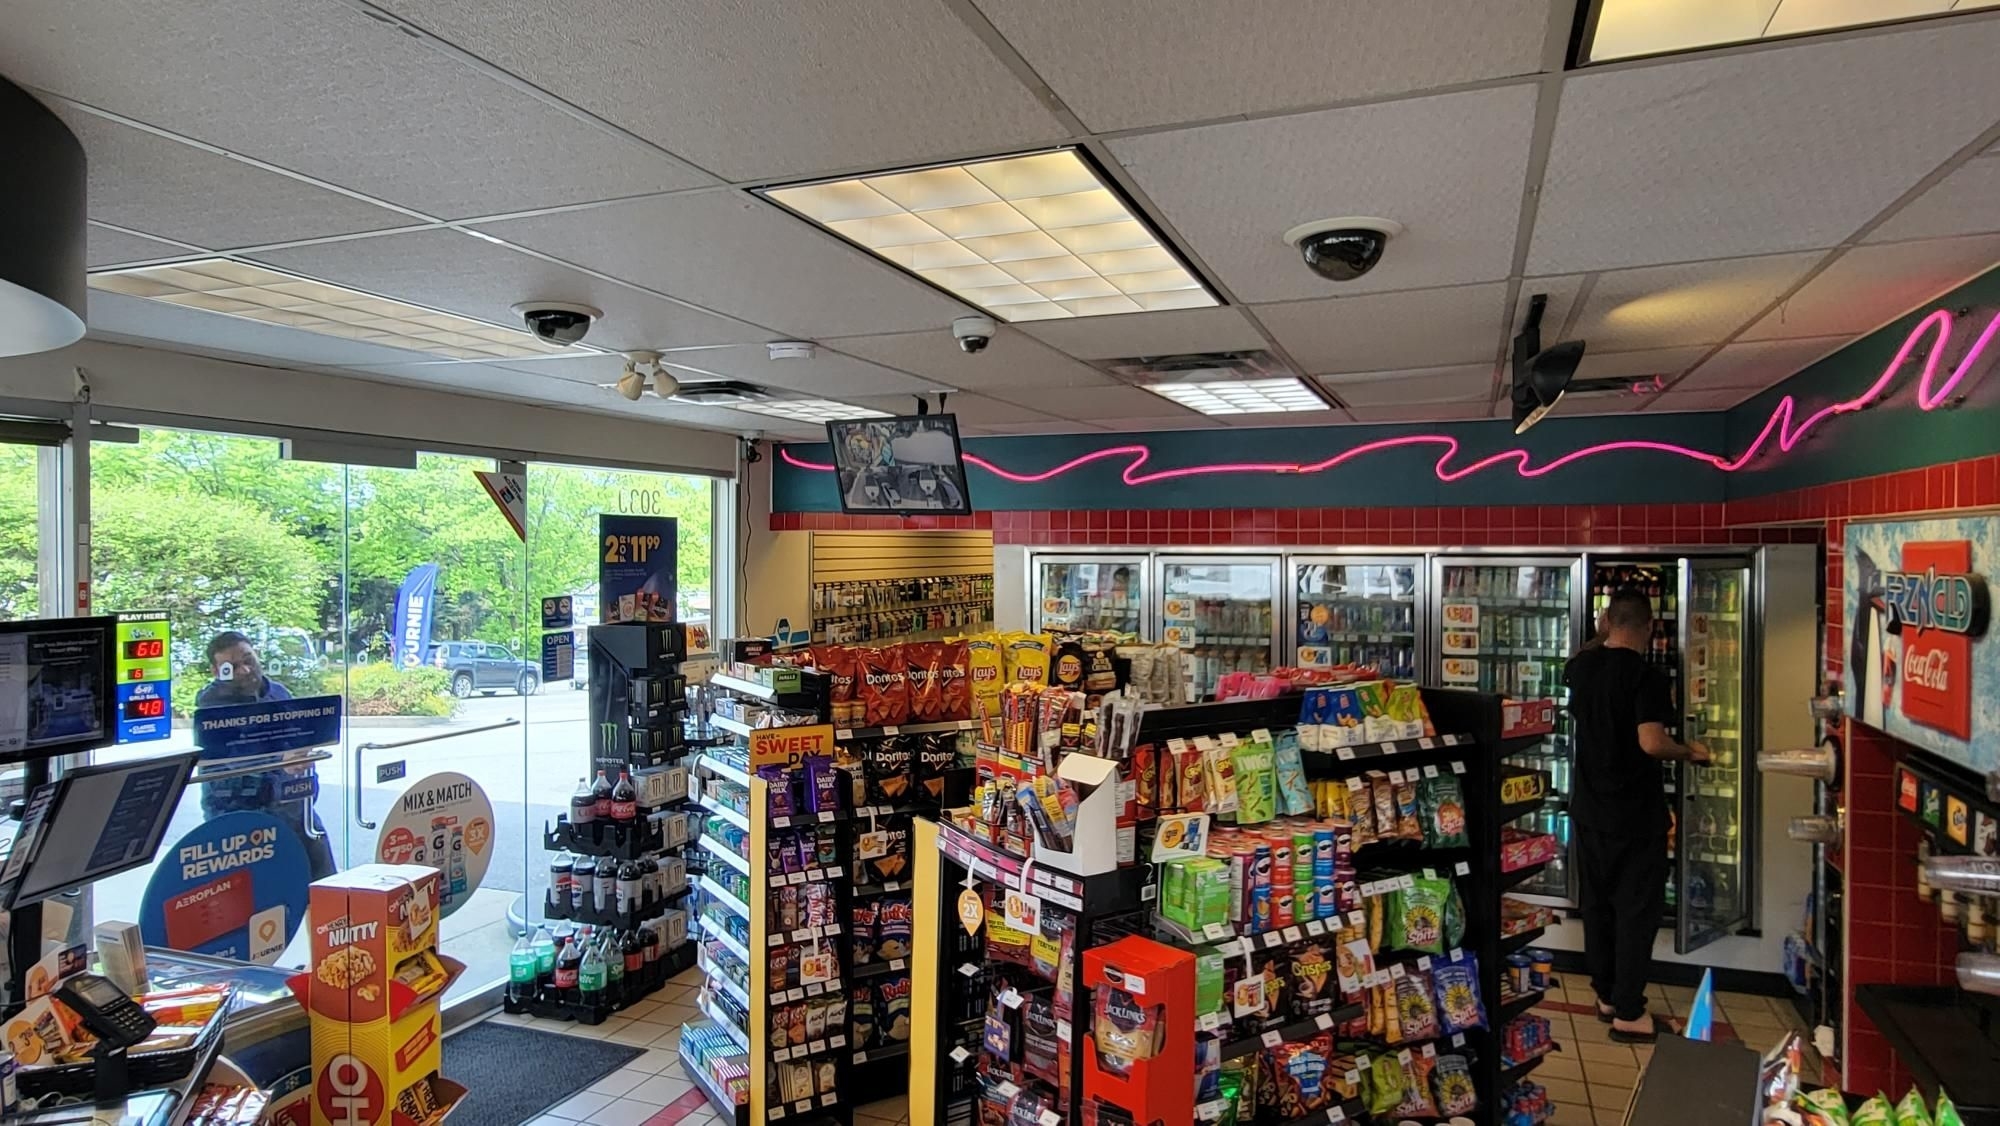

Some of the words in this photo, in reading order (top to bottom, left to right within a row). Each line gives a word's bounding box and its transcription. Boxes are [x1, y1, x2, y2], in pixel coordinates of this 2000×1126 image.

[604, 534, 619, 563] 2
[119, 613, 142, 621] PLAY
[144, 612, 167, 620] HERE
[403, 595, 424, 668] OURNIE
[546, 634, 570, 646] OPEN
[137, 641, 161, 657] 60
[134, 669, 142, 679] 6
[866, 672, 904, 686] Doritos
[139, 700, 161, 716] 48
[202, 717, 247, 730] THANKS
[249, 713, 270, 725] FOR
[272, 707, 321, 722] STOPPING
[322, 706, 336, 716] IN!
[756, 734, 824, 755] SWEET
[788, 750, 821, 766] DAY
[380, 766, 404, 777] PUSH
[284, 781, 312, 795] PUSH
[403, 791, 425, 812] MIX
[426, 790, 435, 806] &
[436, 781, 472, 803] MATCH
[179, 841, 219, 864] FILL
[221, 834, 247, 852] UP
[250, 826, 277, 846] ON
[433, 834, 445, 850] G
[452, 839, 463, 851] G
[182, 844, 275, 881] REWARDS
[414, 850, 424, 862] G
[175, 880, 232, 910] AEROPLAN
[963, 902, 978, 919] 2X
[328, 921, 379, 947] NUTTY
[1407, 929, 1439, 945] Spitz
[1104, 1003, 1122, 1016] JACK
[1405, 1015, 1433, 1036] Spitz
